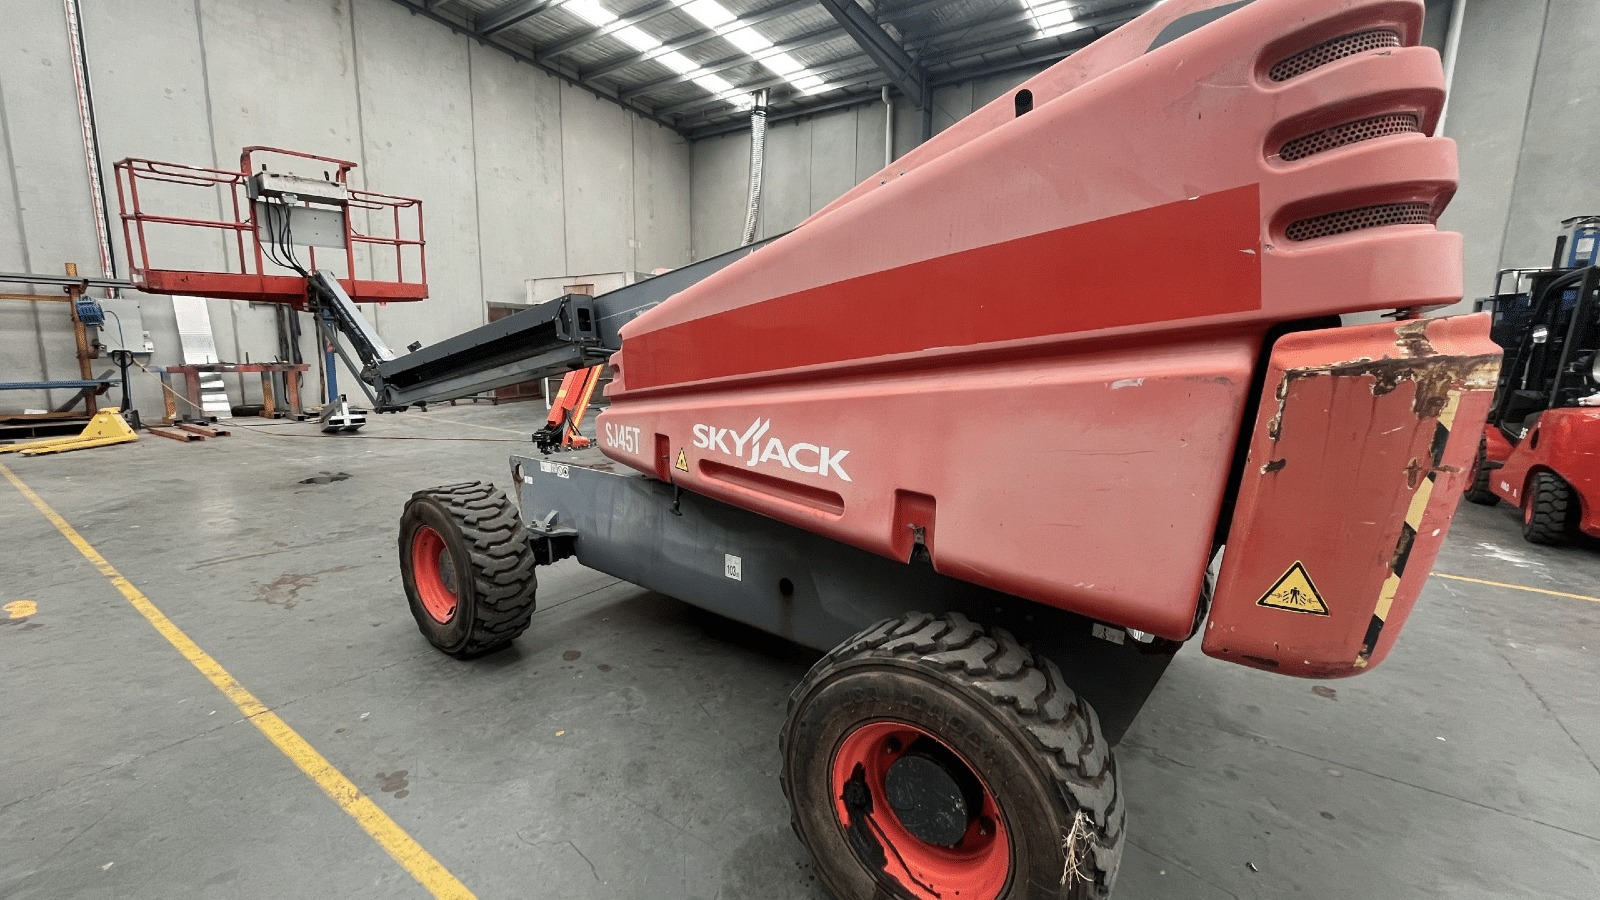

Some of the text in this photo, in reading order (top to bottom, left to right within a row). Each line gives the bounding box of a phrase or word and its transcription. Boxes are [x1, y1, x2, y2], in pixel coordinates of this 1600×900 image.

[605, 421, 641, 455] SJ45T
[692, 416, 853, 482] SKYJACK
[726, 564, 737, 577] 103
